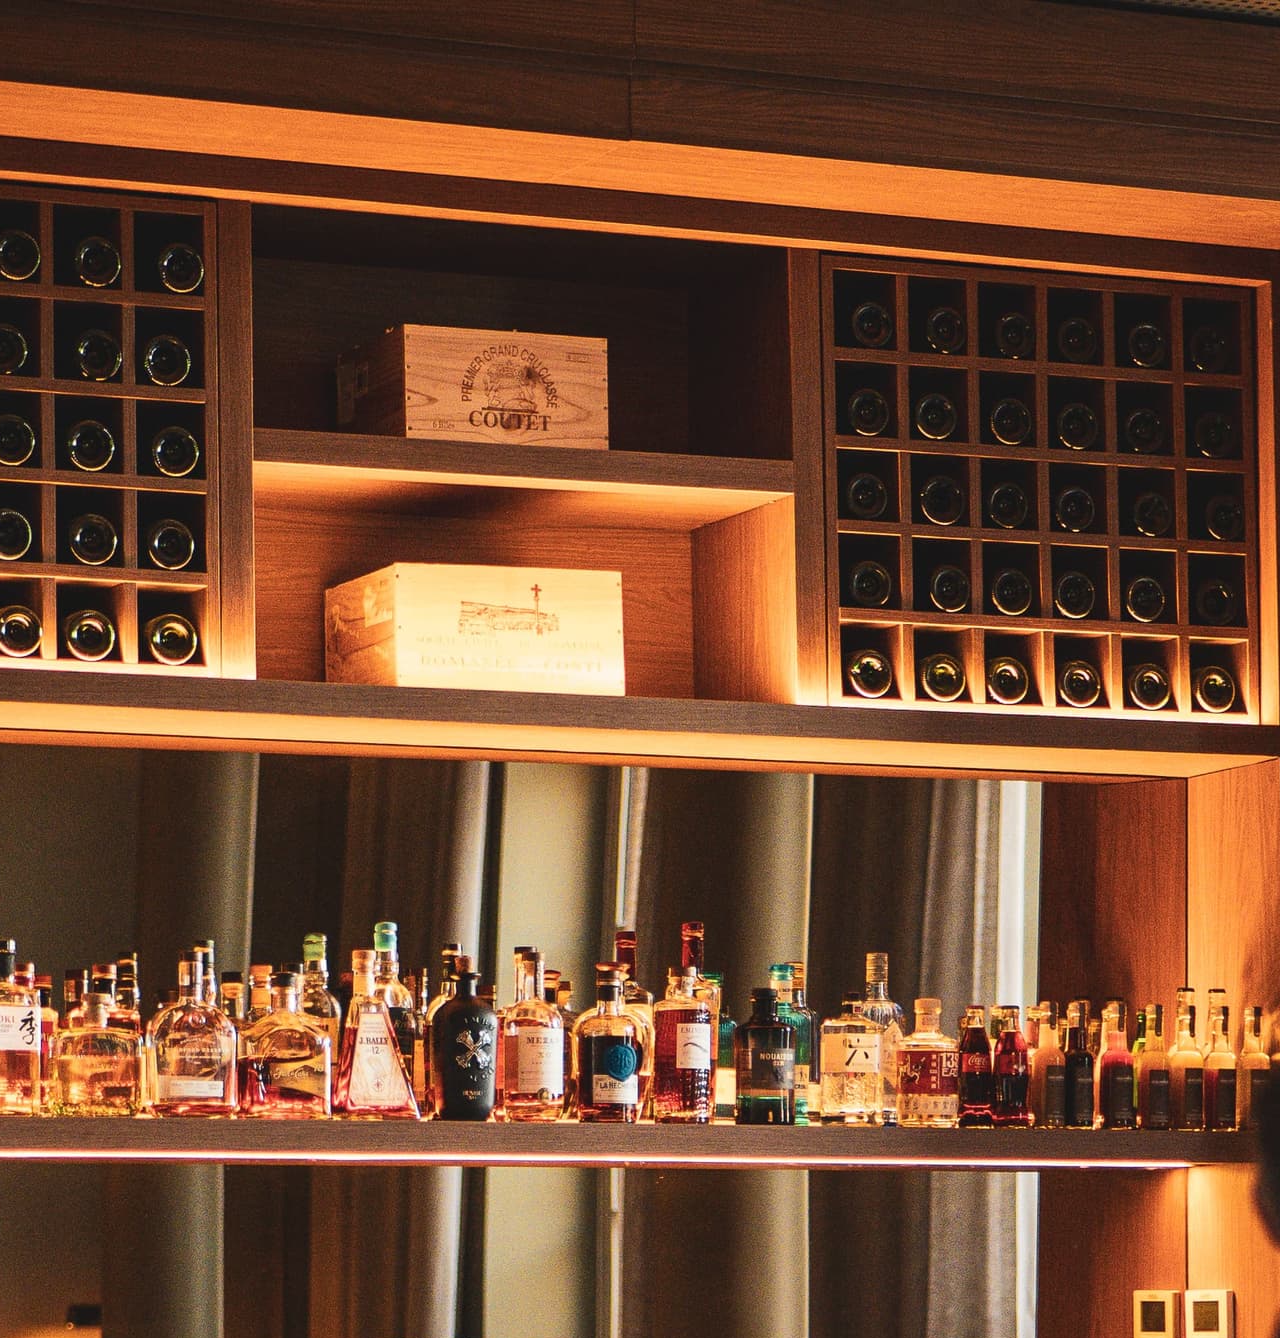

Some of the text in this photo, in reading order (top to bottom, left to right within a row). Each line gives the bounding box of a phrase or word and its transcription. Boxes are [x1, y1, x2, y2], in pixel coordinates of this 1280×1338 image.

[461, 356, 484, 402] PREMIER
[483, 345, 519, 362] GRAND
[521, 349, 542, 369] CRU
[469, 410, 552, 431] COUTET
